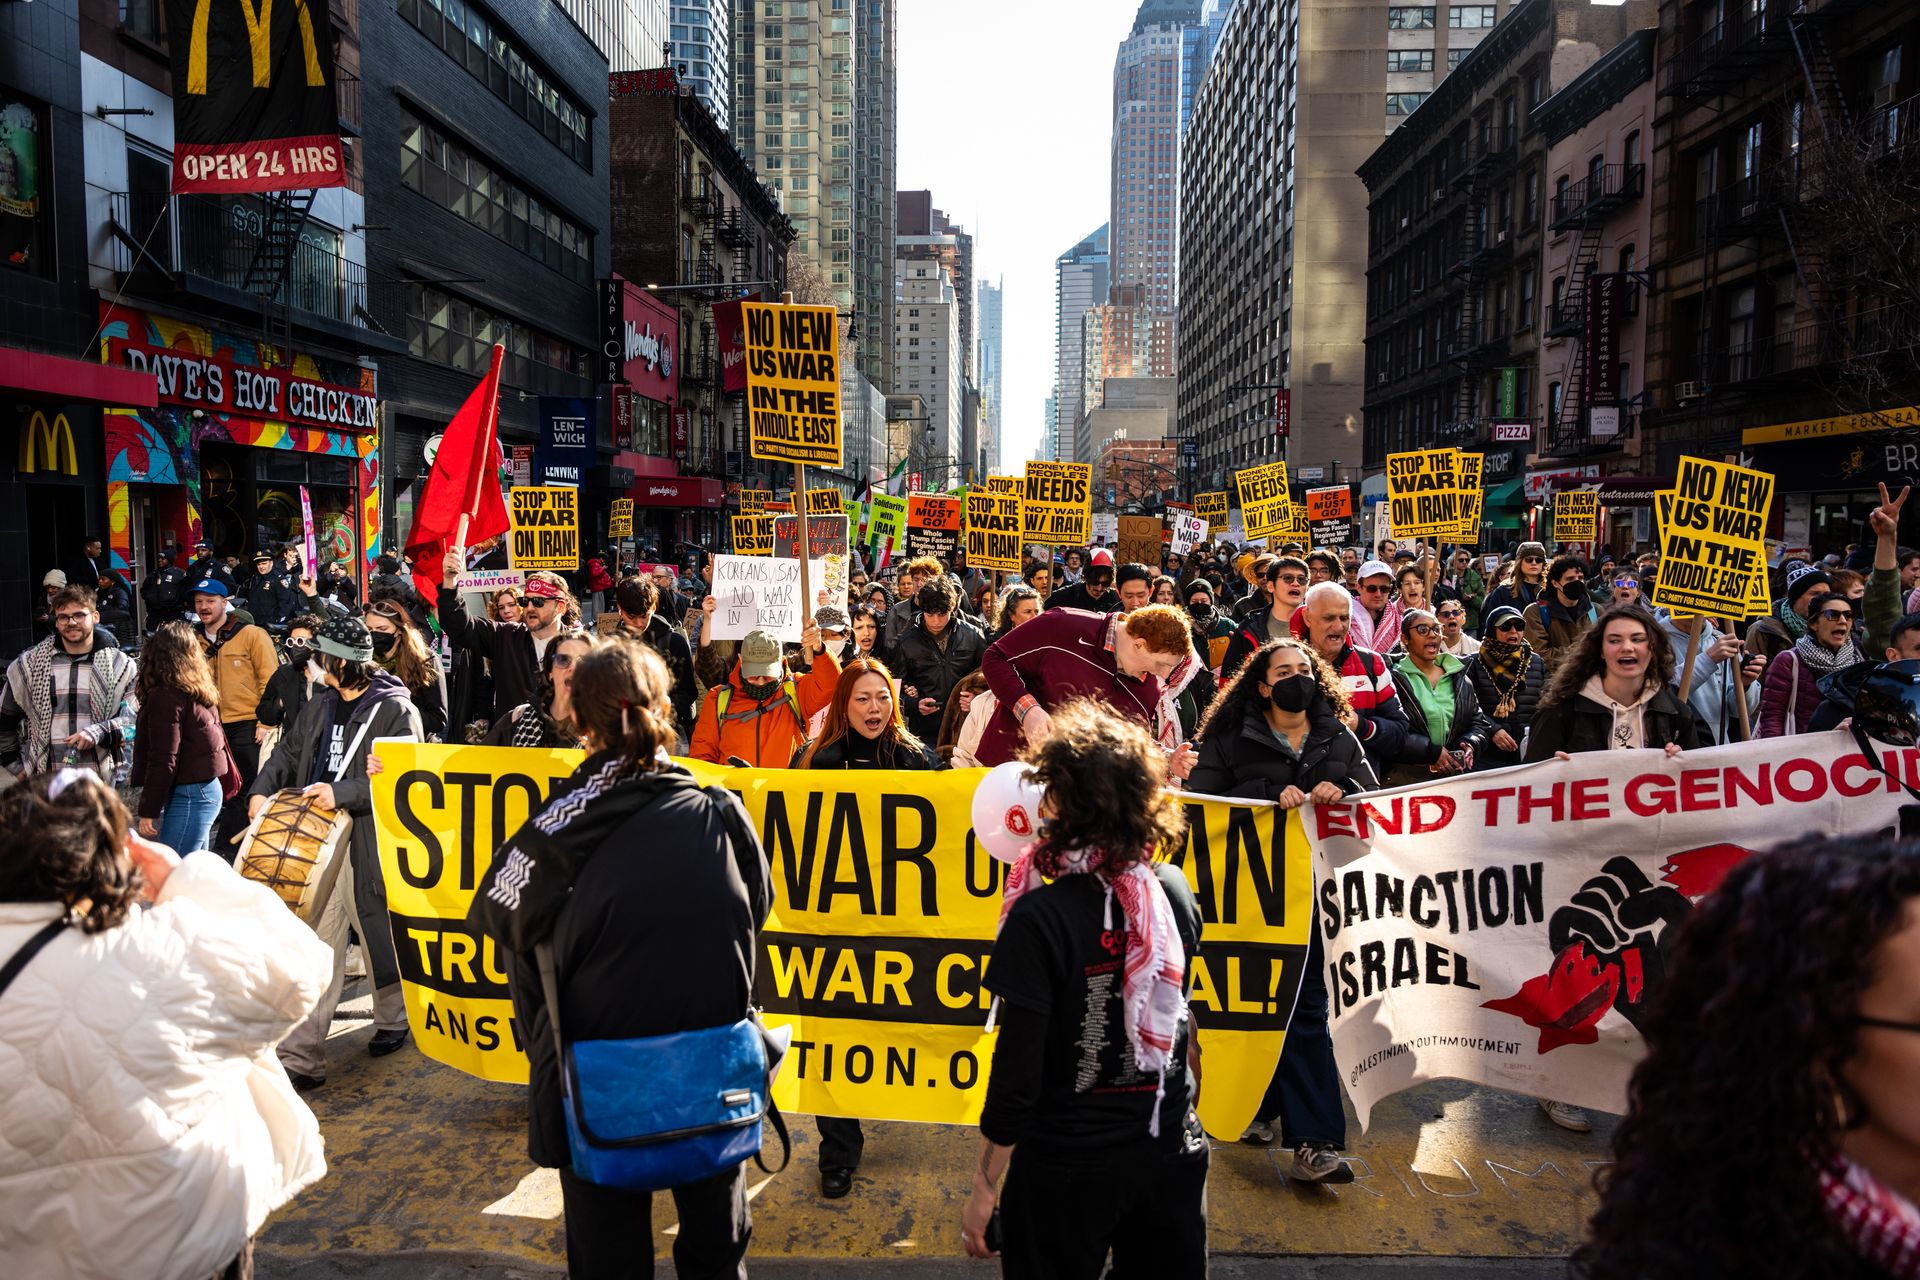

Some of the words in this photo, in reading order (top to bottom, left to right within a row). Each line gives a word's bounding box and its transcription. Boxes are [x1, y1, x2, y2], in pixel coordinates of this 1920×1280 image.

[182, 154, 248, 181] OPEN
[255, 151, 284, 178] 24
[291, 146, 338, 173] HRS
[746, 308, 774, 348] NO
[780, 310, 832, 352] NEW
[624, 320, 660, 371] Wendy's
[750, 348, 777, 377] US
[778, 352, 835, 382] WAR
[234, 368, 280, 413] HOT
[289, 381, 377, 428] CHICKEN
[752, 385, 778, 411] IN
[779, 389, 836, 415] THE
[753, 411, 800, 442] MIDDLE
[802, 416, 837, 445] EAST
[1497, 427, 1528, 438] PIZZA
[1785, 421, 1836, 437] MARKET
[553, 433, 585, 443] WICH
[813, 450, 838, 461] LIBERATION
[1027, 463, 1066, 471] MONEY
[1238, 468, 1267, 478] MONEY
[1267, 464, 1283, 473] FOR
[1390, 455, 1424, 476] STOP
[1427, 453, 1454, 472] THE
[1461, 457, 1480, 473] THE
[545, 467, 579, 480] LENWICH
[1027, 470, 1088, 479] PEOPLE'S
[1239, 469, 1284, 484] PEOPLE'S
[988, 479, 1013, 493] STOP
[1026, 477, 1086, 503] NEEDS
[1240, 476, 1287, 504] NEEDS
[1390, 472, 1456, 493] WAR
[1679, 462, 1718, 501] NO
[1720, 469, 1771, 514] NEW
[513, 491, 547, 509] STOP
[550, 491, 574, 509] THE
[741, 491, 752, 500] NO
[754, 491, 771, 500] NEW
[812, 491, 840, 510] NEW
[1195, 496, 1212, 505] STOP
[1213, 495, 1225, 503] THE
[1320, 492, 1339, 500] ICE
[1558, 494, 1570, 506] NO
[1573, 494, 1595, 506] NEW
[618, 500, 632, 510] NEW
[874, 497, 905, 513] Solidarity
[924, 499, 947, 509] ICE
[968, 496, 995, 514] STOP
[998, 498, 1019, 516] THE
[1024, 506, 1052, 514] NOT
[1054, 508, 1084, 516] WAR
[1196, 503, 1226, 513] WAR
[1244, 504, 1266, 514] NOT
[1266, 499, 1288, 509] WAR
[1314, 500, 1346, 510] MUST
[1392, 497, 1413, 526] ON
[1417, 493, 1458, 524] IRAN!
[1557, 506, 1570, 515] US
[1571, 506, 1594, 515] WAR
[513, 510, 575, 527] WAR
[880, 511, 894, 521] with
[915, 508, 955, 518] MUST
[1208, 513, 1227, 527] IRAN!
[1245, 512, 1263, 529] W/
[1267, 505, 1290, 525] IRAN
[1321, 508, 1342, 517] GO!
[922, 518, 948, 527] GO!
[968, 513, 1019, 532] WAR
[1025, 514, 1046, 531] W/
[1050, 515, 1083, 534] IRAN
[1127, 520, 1151, 535] NO
[1674, 500, 1710, 530] US
[1713, 506, 1763, 541] WAR
[734, 520, 753, 537] NO
[756, 520, 774, 536] NE
[808, 521, 840, 540] WILL
[873, 521, 896, 537] IRAN
[922, 529, 943, 537] Whole
[1177, 528, 1200, 542] WAR
[1312, 526, 1331, 534] Trump
[1314, 531, 1334, 540] Regime
[1395, 525, 1458, 537] PSLWEB.ORG
[1556, 526, 1577, 534] MIDDLE
[1578, 526, 1592, 534] EAST
[515, 530, 535, 558] ON
[539, 530, 576, 557] IRAN!
[736, 538, 756, 550] US
[910, 535, 930, 544] Trump
[931, 536, 955, 544] Fascist
[968, 531, 985, 556] ON
[987, 533, 1020, 559] IRAN!
[1024, 532, 1082, 543] ANSWERCOALITION.ORG
[911, 541, 936, 551] Regime
[937, 543, 953, 551] Must
[917, 549, 927, 557] Go
[927, 549, 947, 557] NOW!
[1666, 535, 1702, 561] IN
[1705, 541, 1757, 573] THE
[515, 560, 576, 568] PSLWEB.ORG
[717, 560, 766, 582] KOREANS
[777, 562, 800, 582] SAY
[968, 558, 1019, 569] PSLWEB.ORG
[472, 570, 500, 578] THAN
[1660, 560, 1719, 594] MIDDLE
[1717, 570, 1751, 600] EAST
[457, 576, 520, 588] COMATOSE
[733, 584, 754, 605] NO
[764, 584, 794, 606] WAR
[1668, 593, 1684, 603] PARTY
[1684, 596, 1695, 604] FOR
[1695, 597, 1716, 608] SOCIALISM
[1720, 601, 1744, 614] LIBERATION
[728, 609, 741, 625] IN
[756, 609, 793, 627] IRAN!
[1316, 795, 1456, 841] END
[1472, 779, 1611, 827] THE
[394, 769, 562, 890] STO
[737, 790, 940, 917] WAR
[1169, 803, 1287, 928] AN
[1320, 861, 1544, 940] SANCTION
[407, 928, 510, 985] TRU
[767, 944, 915, 1007] WAR
[1329, 937, 1481, 1018] ISRAEL
[1351, 1035, 1522, 1087] @PALESTINIANYOUTHMOVEMENT
